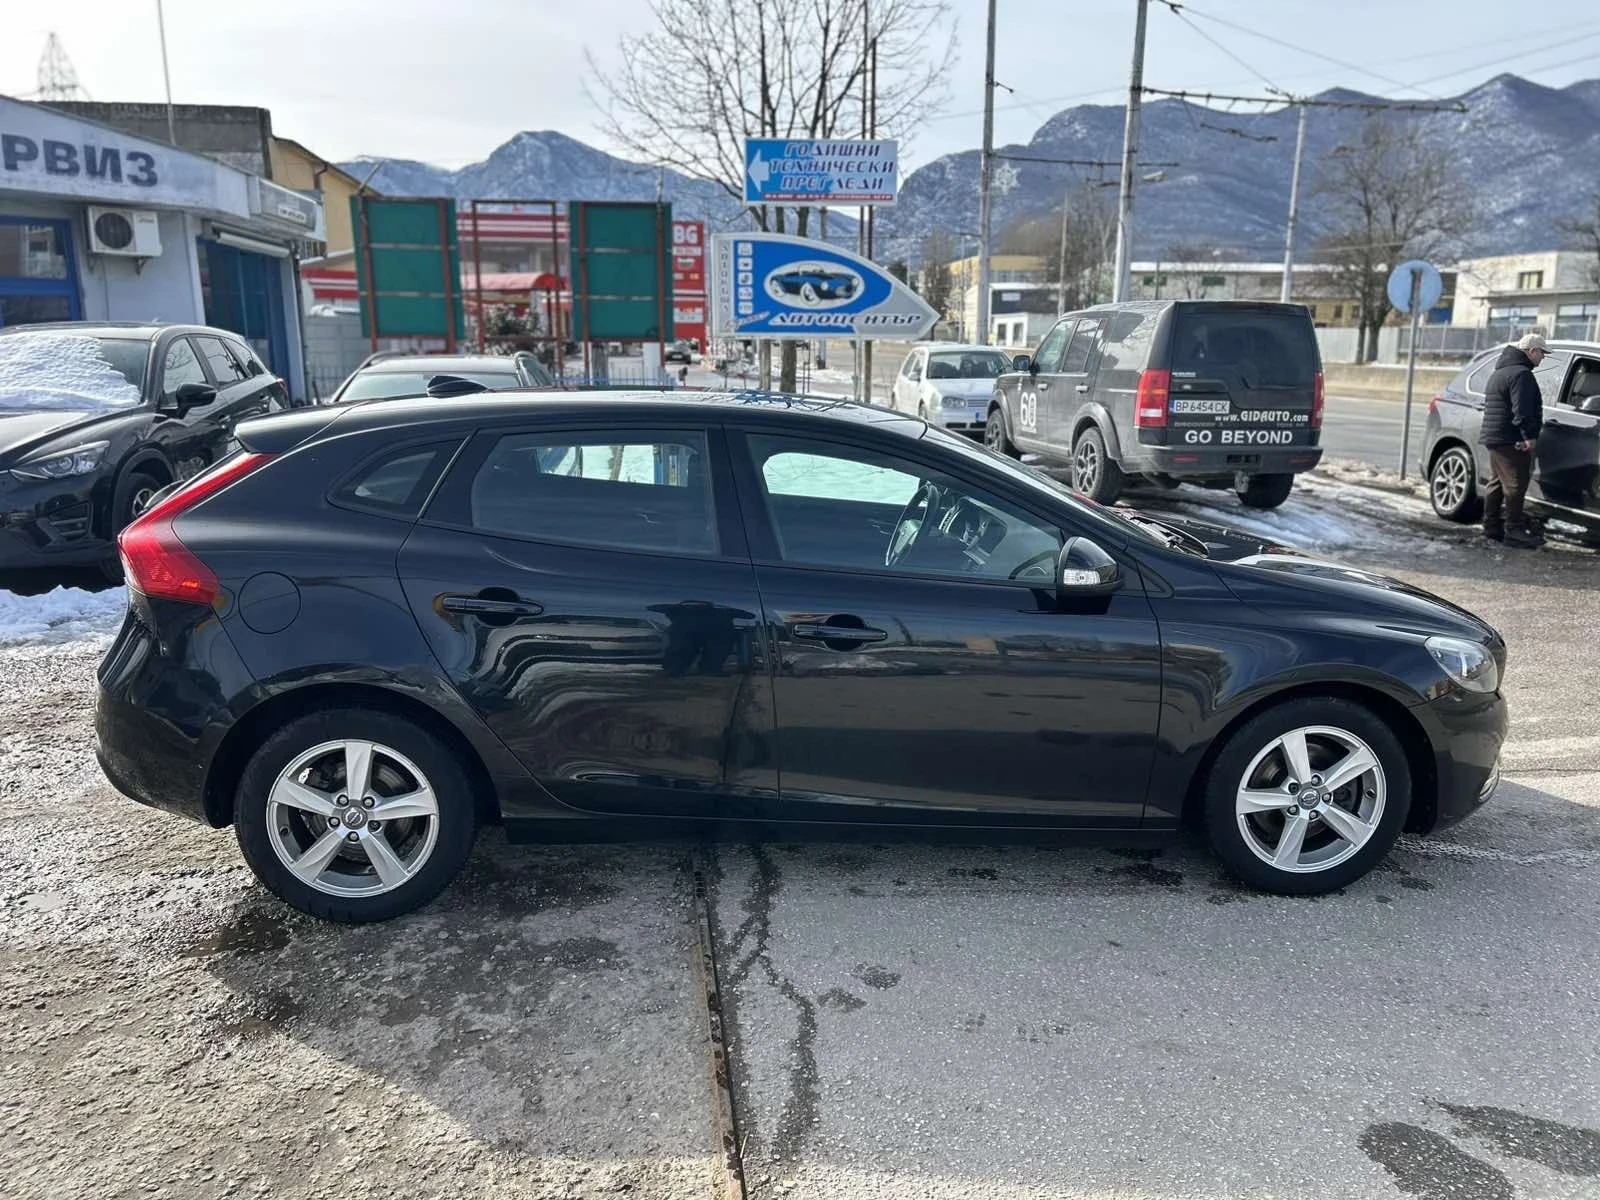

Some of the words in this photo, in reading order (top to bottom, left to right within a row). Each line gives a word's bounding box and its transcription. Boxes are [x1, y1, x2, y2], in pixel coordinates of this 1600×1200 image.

[785, 142, 881, 157] ГОДИШНИ
[770, 158, 895, 174] ТЕХНИЧЕСКИ
[781, 174, 884, 190] ПРЕГЛЕДИ
[1020, 391, 1037, 428] 60
[1190, 401, 1214, 412] 6454
[1215, 411, 1309, 423] www.GIDAUTO.com
[1184, 430, 1213, 443] GO
[1220, 430, 1293, 444] BEYOND
